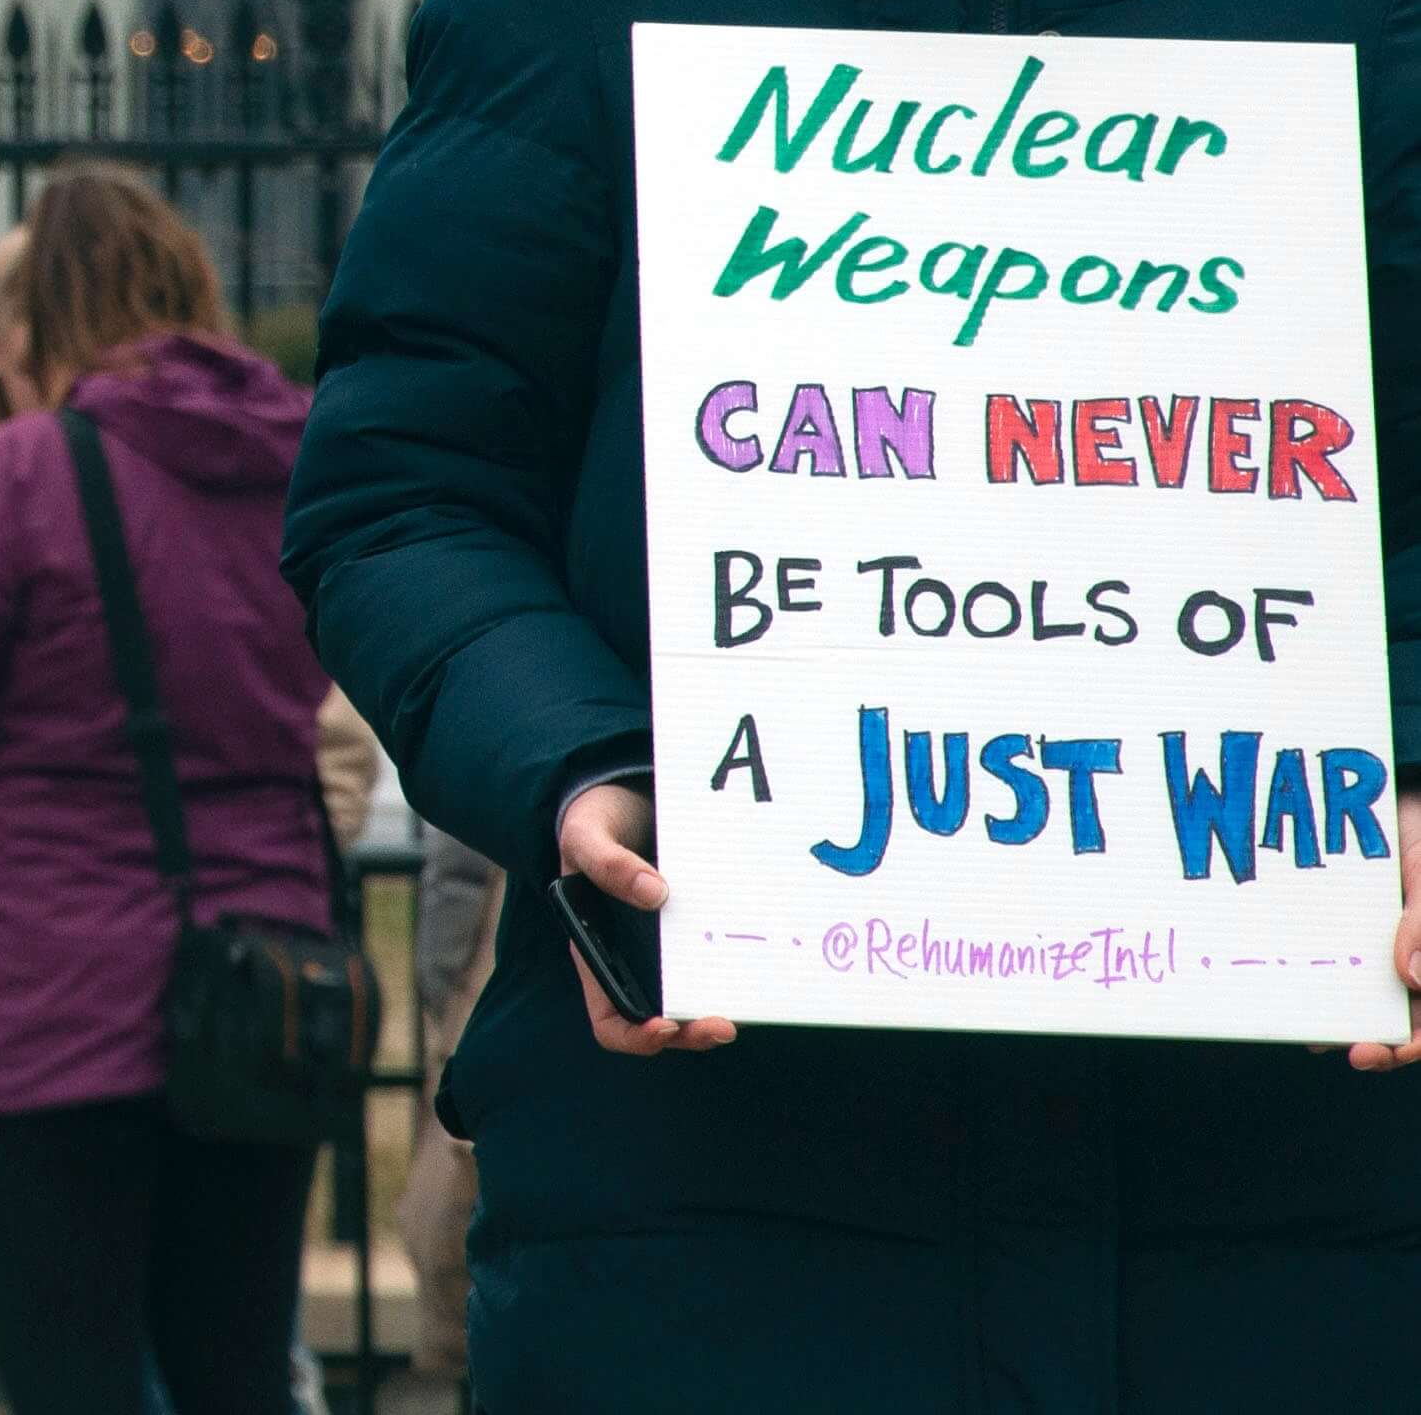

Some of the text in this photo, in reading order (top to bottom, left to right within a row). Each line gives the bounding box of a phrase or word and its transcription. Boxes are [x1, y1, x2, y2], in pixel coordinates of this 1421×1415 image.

[714, 55, 1228, 184] Nuclear
[711, 205, 1246, 347] Weapons
[694, 380, 1359, 503] CAN NEVER
[713, 549, 1314, 663] BE TOOLS OF
[709, 703, 1392, 884] A JUST WAR
[820, 917, 1177, 990] @RehumanizeIntl
